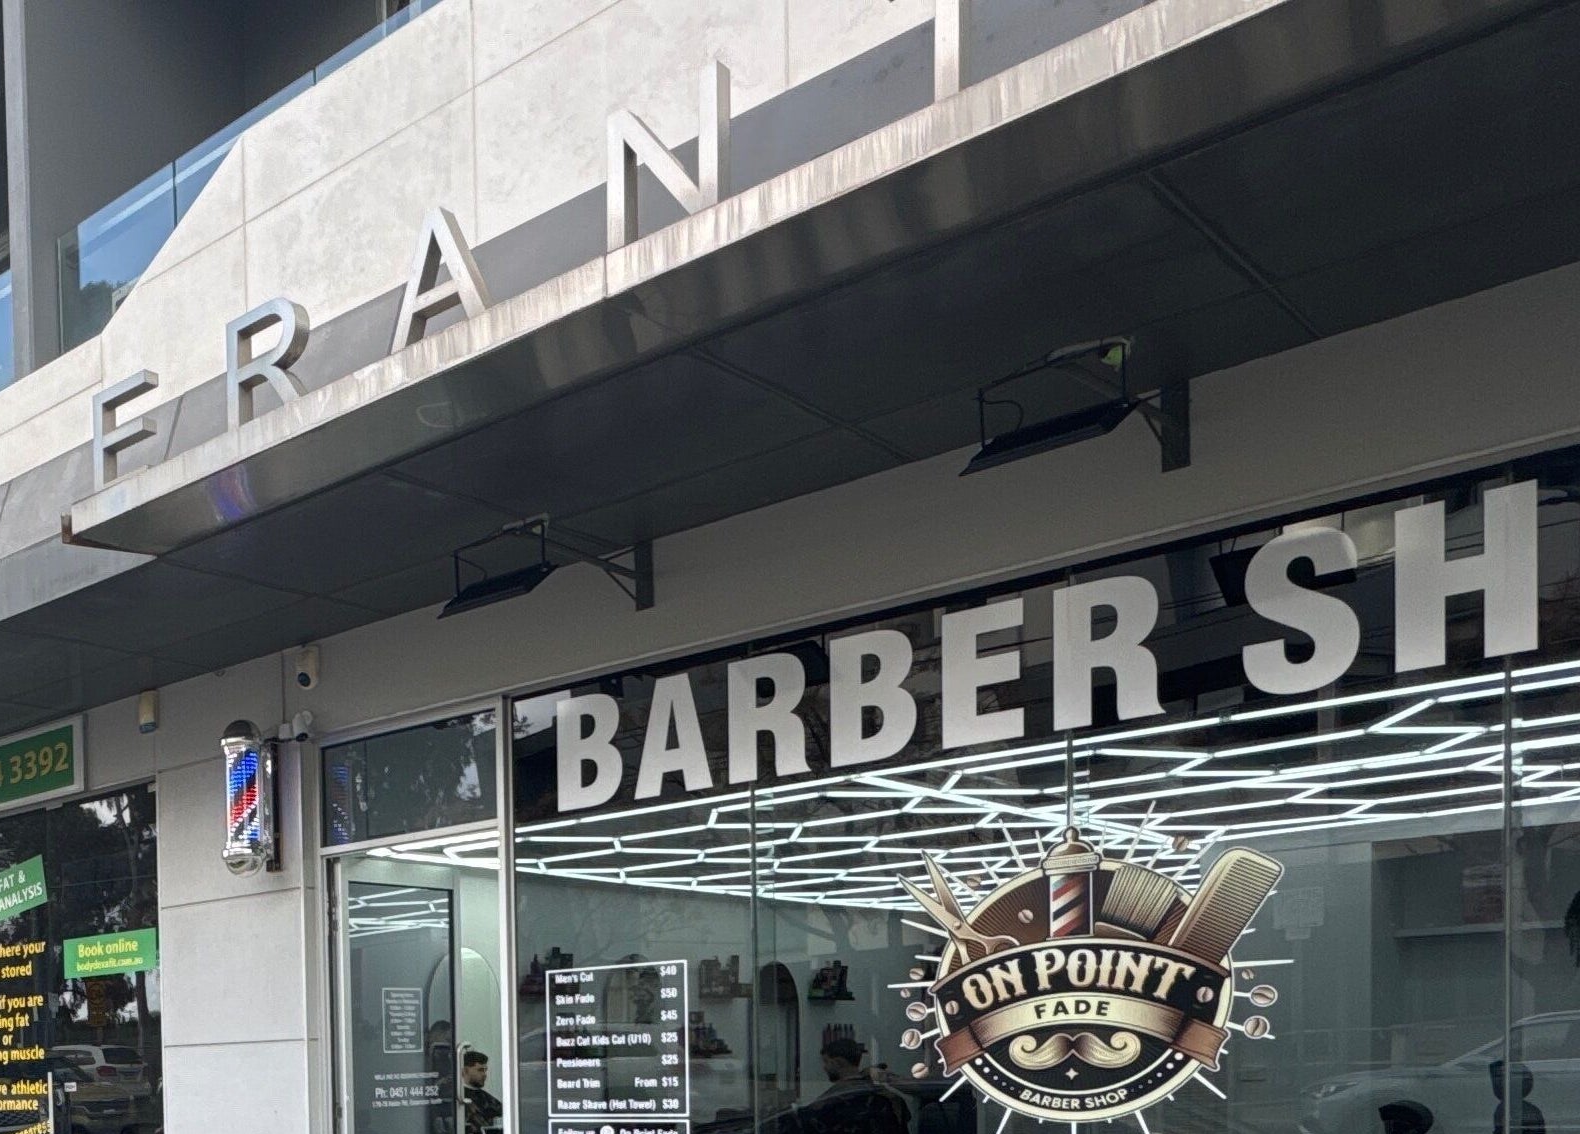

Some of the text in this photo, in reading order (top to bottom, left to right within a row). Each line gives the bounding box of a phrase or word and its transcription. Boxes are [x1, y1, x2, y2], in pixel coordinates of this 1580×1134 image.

[556, 478, 1539, 813] BARBER SH
[9, 741, 70, 785] 3392
[18, 870, 26, 884] &
[23, 940, 46, 959] your
[77, 938, 139, 958] Book online
[1, 961, 32, 979] stored
[580, 972, 594, 982] Cut
[660, 965, 677, 977] $40
[961, 948, 1196, 1011] ON POINT
[7, 997, 26, 1013] you
[27, 994, 44, 1007] are
[555, 995, 574, 1005] Skin
[575, 993, 595, 1004] Fade
[556, 1010, 678, 1026] Zero Fade $45
[1033, 1000, 1111, 1020] FADE
[15, 1013, 30, 1027] fat
[2, 1034, 14, 1046] or
[592, 1035, 610, 1046] Kids
[627, 1033, 652, 1046] (U10)
[661, 1032, 678, 1043] $25
[10, 1044, 45, 1060] muscle
[556, 1054, 679, 1068] Pensioners $25
[11, 1079, 48, 1095] athletic
[557, 1076, 679, 1089] Beard Trim From $15
[628, 1098, 656, 1110] Towel)
[1019, 1088, 1129, 1110] BARBER SHOP
